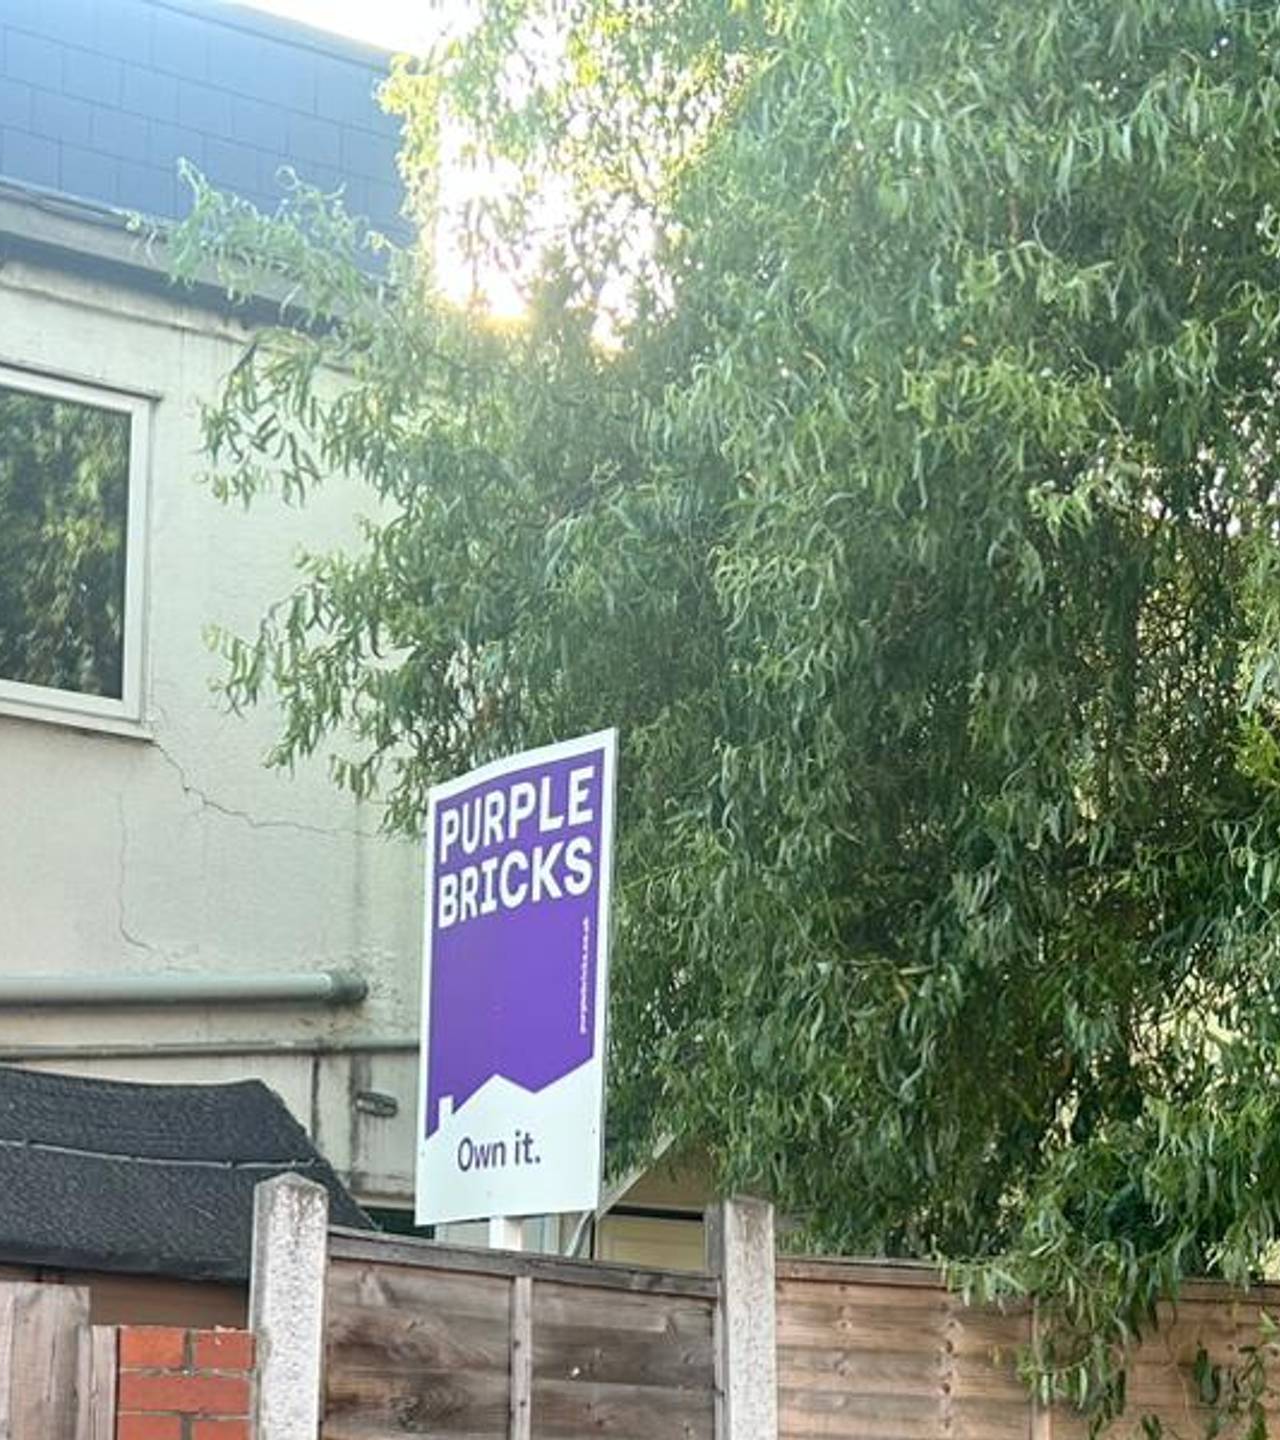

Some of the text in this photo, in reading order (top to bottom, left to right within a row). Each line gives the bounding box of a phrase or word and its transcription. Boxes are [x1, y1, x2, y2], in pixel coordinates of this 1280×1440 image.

[440, 766, 595, 864] PURPLE
[438, 836, 593, 928] BRICKS
[457, 1129, 541, 1172] Own it.
